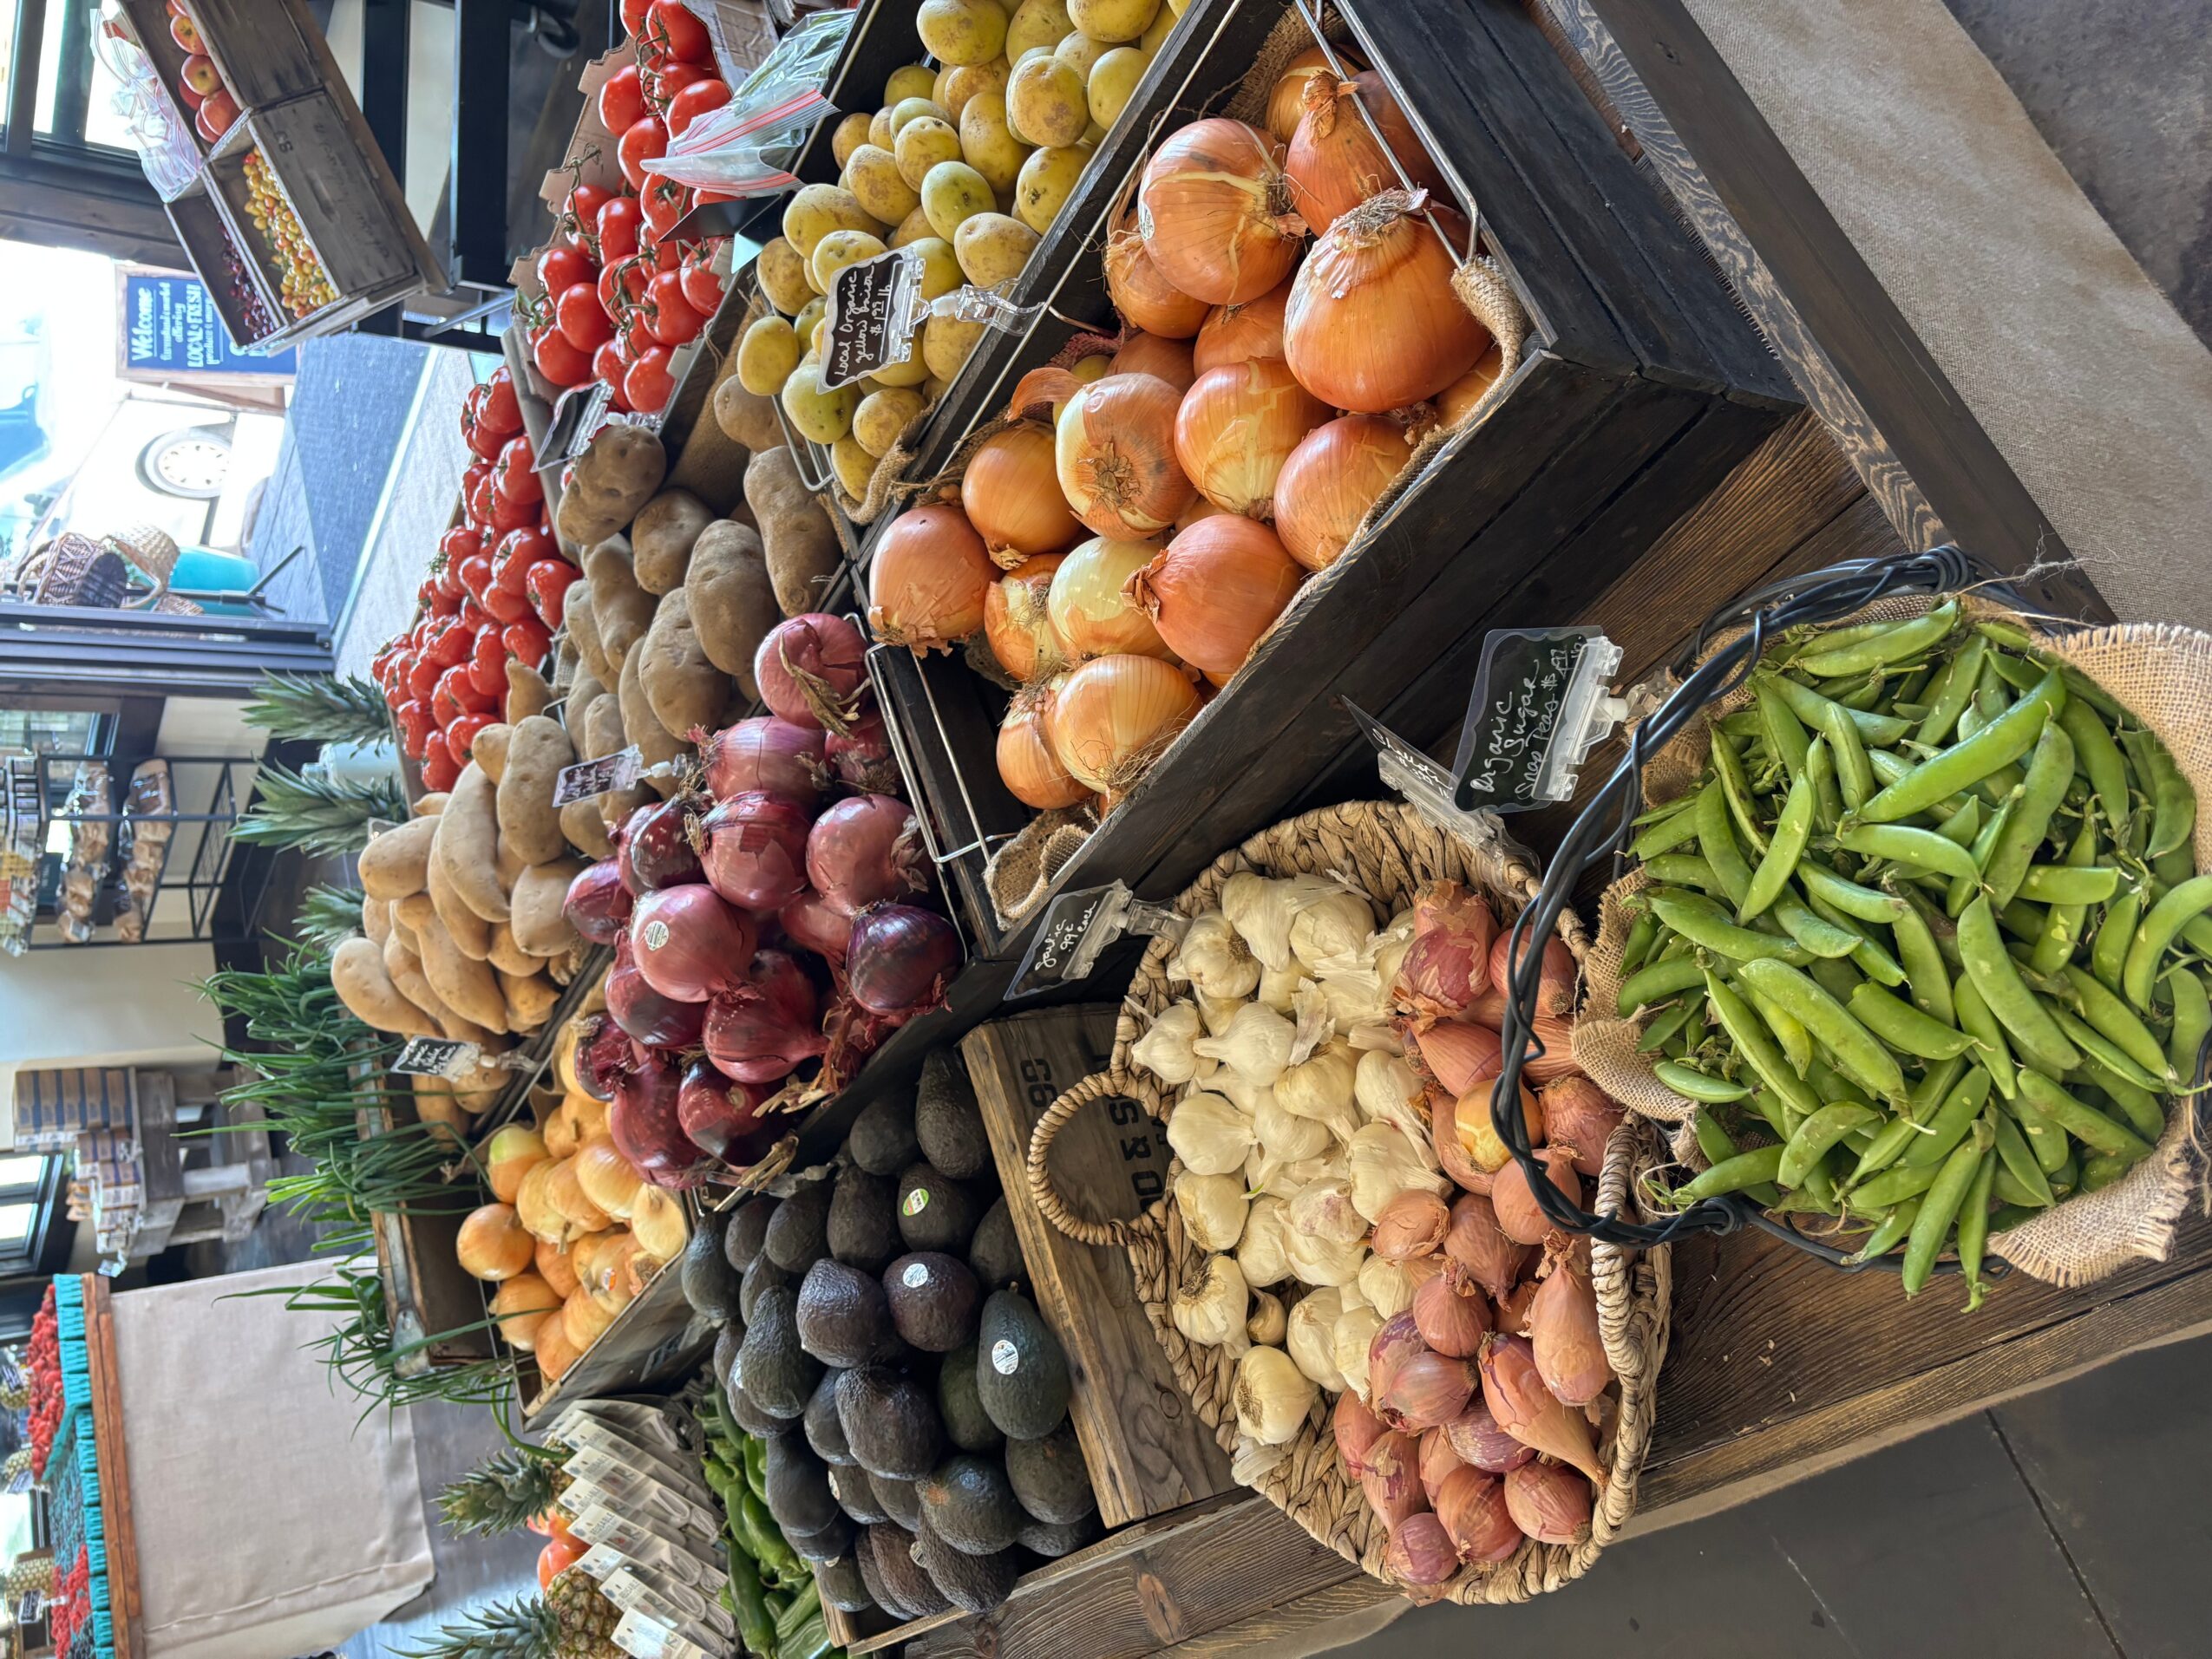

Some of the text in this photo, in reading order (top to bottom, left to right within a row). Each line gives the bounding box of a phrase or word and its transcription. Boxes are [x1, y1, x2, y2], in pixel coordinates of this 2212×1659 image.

[131, 287, 154, 361] Welcome
[172, 303, 187, 343] offering
[834, 270, 860, 376] Local Organic
[1469, 691, 1514, 793] Organic
[1526, 693, 1559, 748] Peas
[1515, 750, 1544, 800] Snap
[1077, 900, 1098, 932] each
[1019, 1058, 1058, 1107] 99
[1119, 1136, 1152, 1161] &
[589, 1512, 616, 1536] REUSABLE
